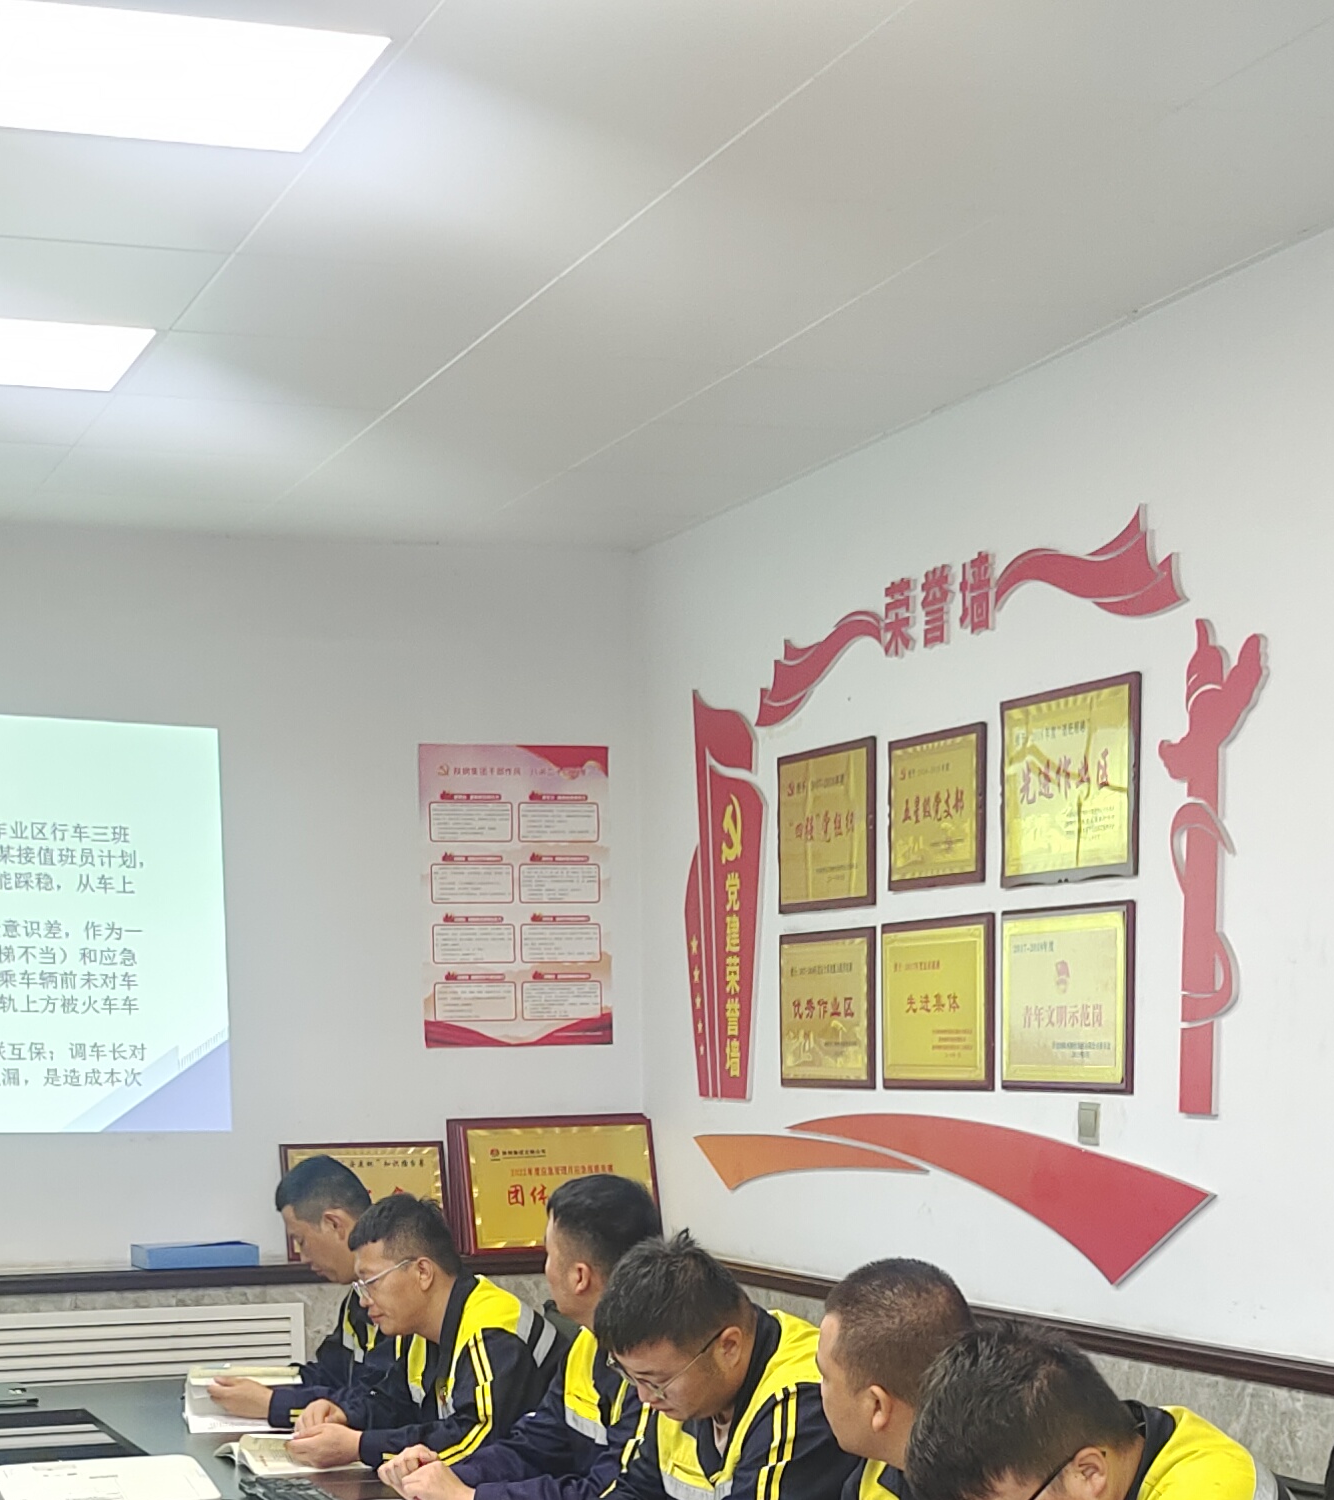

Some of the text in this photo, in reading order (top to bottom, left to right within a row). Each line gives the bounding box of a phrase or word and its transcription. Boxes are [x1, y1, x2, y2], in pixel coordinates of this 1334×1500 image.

[884, 551, 994, 656] 荣誉墙
[725, 872, 741, 1078] 党建荣誉墙
[793, 997, 855, 1019] 优秀作业区
[906, 992, 960, 1014] 先进集体
[1023, 1004, 1103, 1028] 青年文明示范岗
[508, 1183, 548, 1207] 团体
